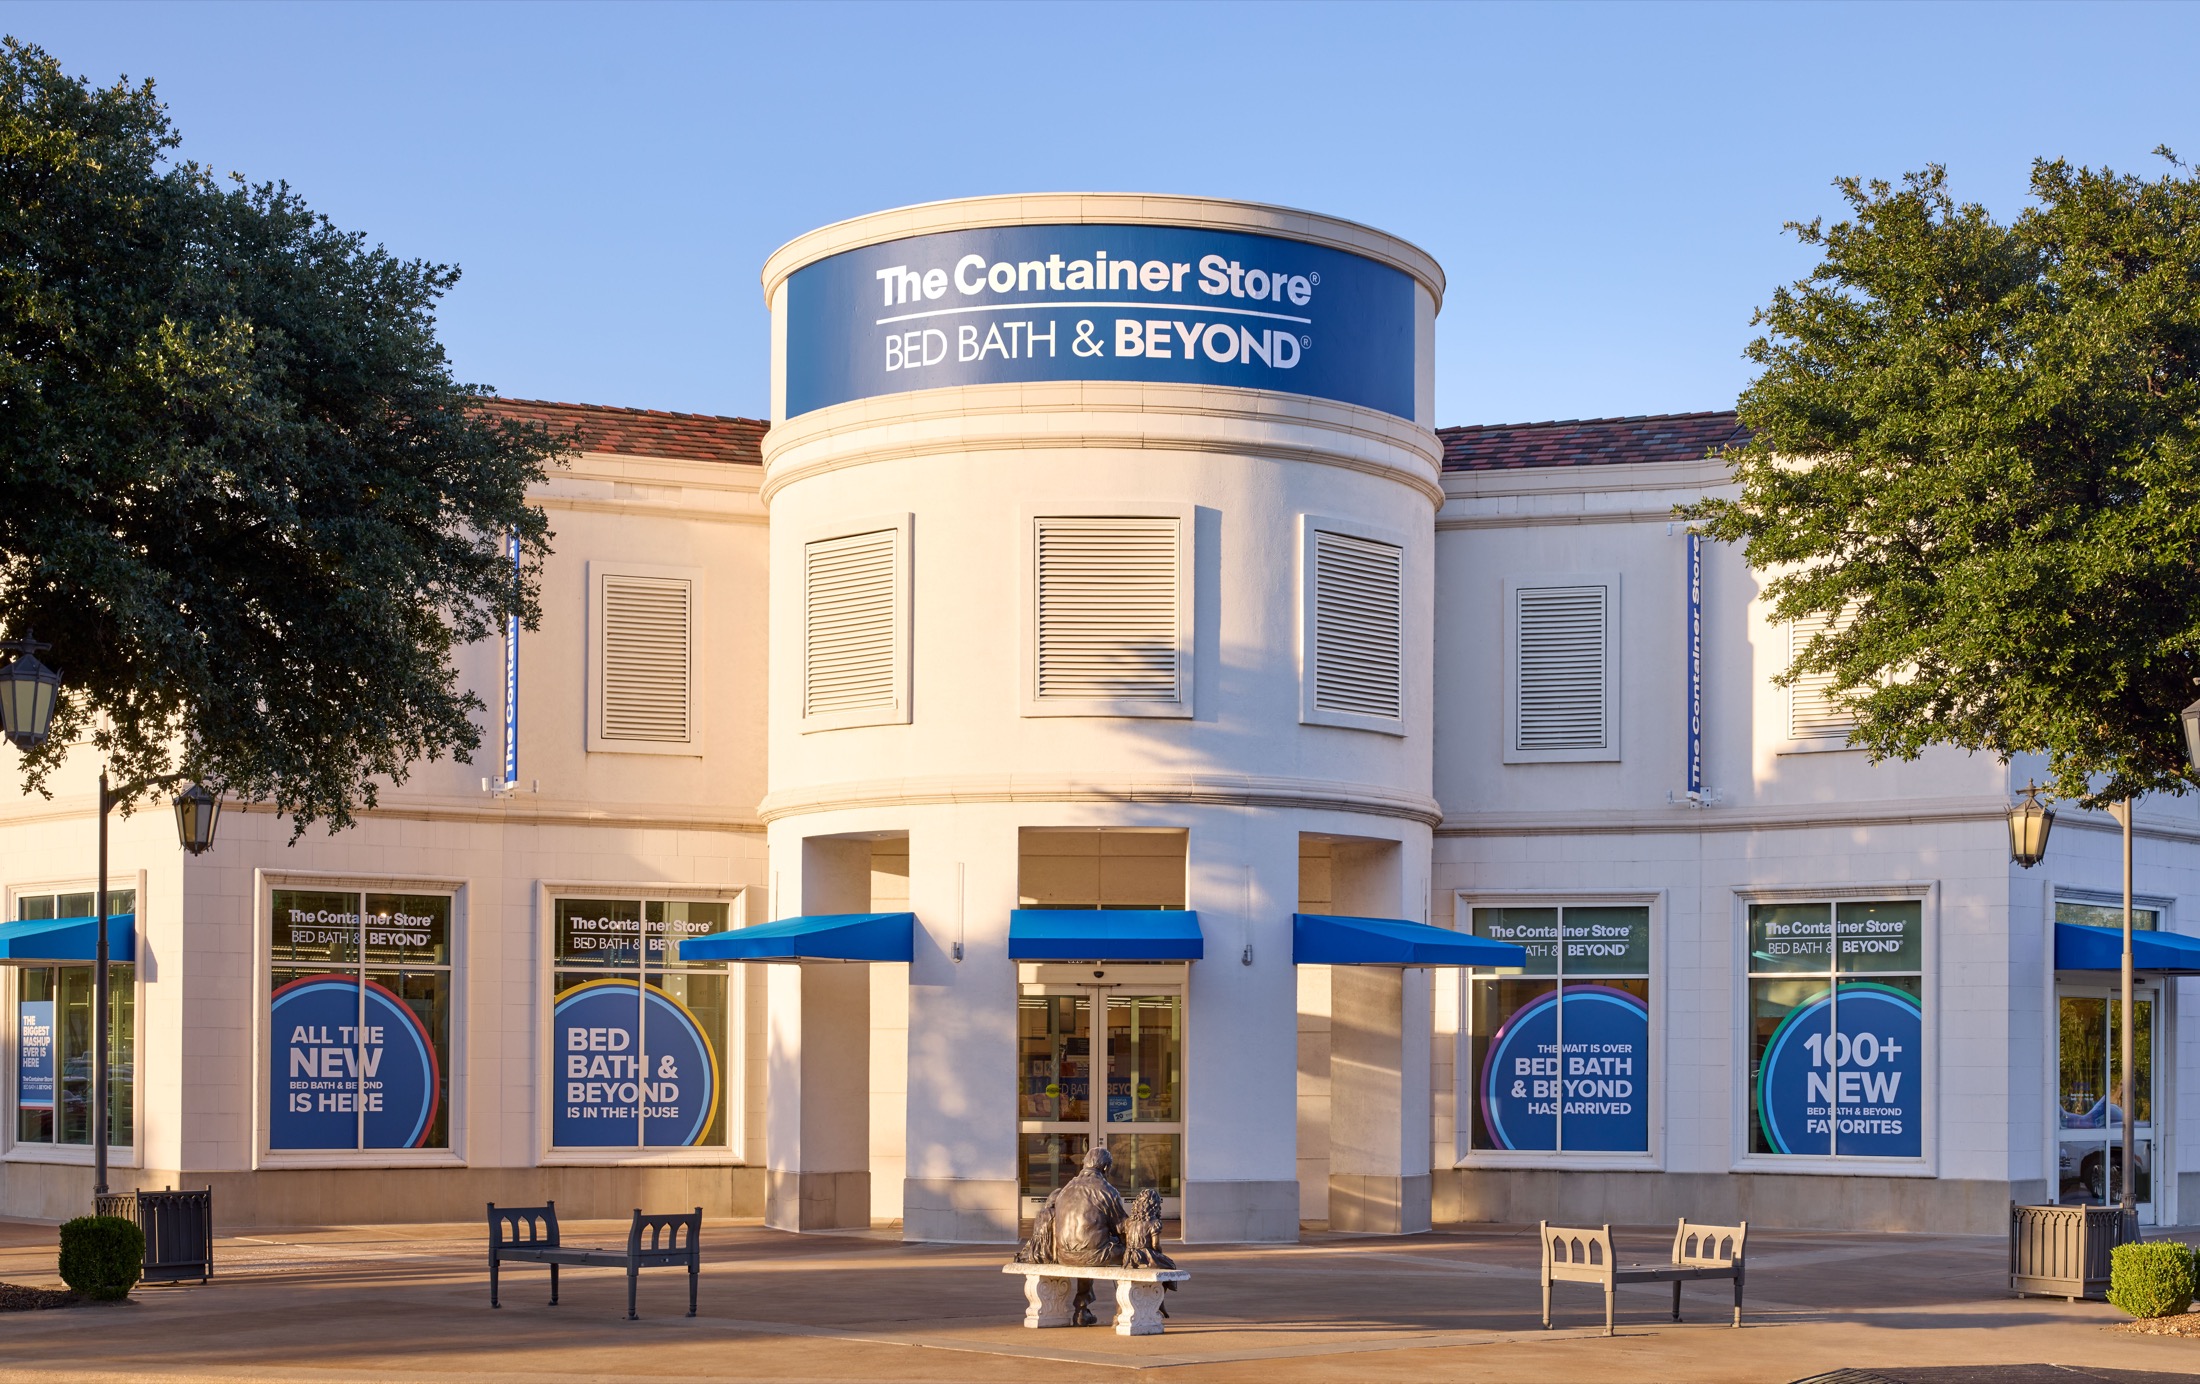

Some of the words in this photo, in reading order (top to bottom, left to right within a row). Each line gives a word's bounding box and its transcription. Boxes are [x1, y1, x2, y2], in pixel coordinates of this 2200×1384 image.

[876, 265, 948, 306] The
[954, 251, 1190, 295] Container
[886, 329, 948, 372] BED
[959, 321, 1056, 362] BATH
[1072, 319, 1104, 357] &
[1692, 535, 1700, 604] Store
[1692, 608, 1700, 735] Container
[1692, 739, 1700, 787] The
[288, 910, 315, 923] The
[317, 910, 392, 925] Container
[570, 917, 596, 930] The
[598, 918, 670, 932] Container
[1489, 926, 1514, 938] The
[1516, 925, 1589, 937] Container
[1765, 922, 1790, 934] The
[1792, 921, 1864, 934] Container
[292, 930, 315, 943] BED
[318, 932, 348, 944] BATH
[574, 938, 596, 949] BED
[600, 938, 629, 950] BATH
[1526, 945, 1547, 956] ATH
[1768, 942, 1790, 954] BED
[1793, 942, 1822, 954] BATH
[23, 1016, 36, 1026] THE
[23, 1026, 50, 1036] BIGGEST
[290, 1026, 333, 1044] ALL
[339, 1026, 384, 1044] THE
[23, 1036, 50, 1046] MASHUP
[568, 1028, 630, 1051] BED
[23, 1047, 39, 1057] EVER
[40, 1047, 46, 1057] IS
[1538, 1044, 1558, 1053] THE
[1562, 1044, 1588, 1052] WAIT
[1590, 1044, 1600, 1052] IS
[1602, 1044, 1632, 1052] OVER
[1804, 1032, 1902, 1067] 100+
[22, 1058, 40, 1068] HERE
[290, 1048, 384, 1078] NEW
[568, 1055, 649, 1078] BATH
[658, 1055, 678, 1078] &
[1516, 1058, 1558, 1076] BED
[1569, 1058, 1632, 1076] BATH
[290, 1082, 308, 1090] BED
[311, 1082, 335, 1090] BATH
[336, 1082, 344, 1090] &
[346, 1082, 383, 1090] BEOND
[568, 1082, 680, 1104] BEYOND
[1511, 1080, 1528, 1098] &
[1534, 1080, 1632, 1098] BEYOND
[1808, 1072, 1902, 1104] NEW
[290, 1093, 312, 1112] IS
[318, 1093, 383, 1112] HERE
[1528, 1102, 1558, 1114] HAS
[1563, 1102, 1632, 1114] ARRIVED
[568, 1107, 580, 1118] IS
[583, 1107, 598, 1118] IN
[600, 1107, 628, 1118] THE
[631, 1107, 678, 1118] HOUSE
[1807, 1107, 1826, 1116] BED
[1854, 1108, 1861, 1116] &
[1863, 1108, 1902, 1116] BEYOND
[1807, 1119, 1902, 1134] FAVORITES
